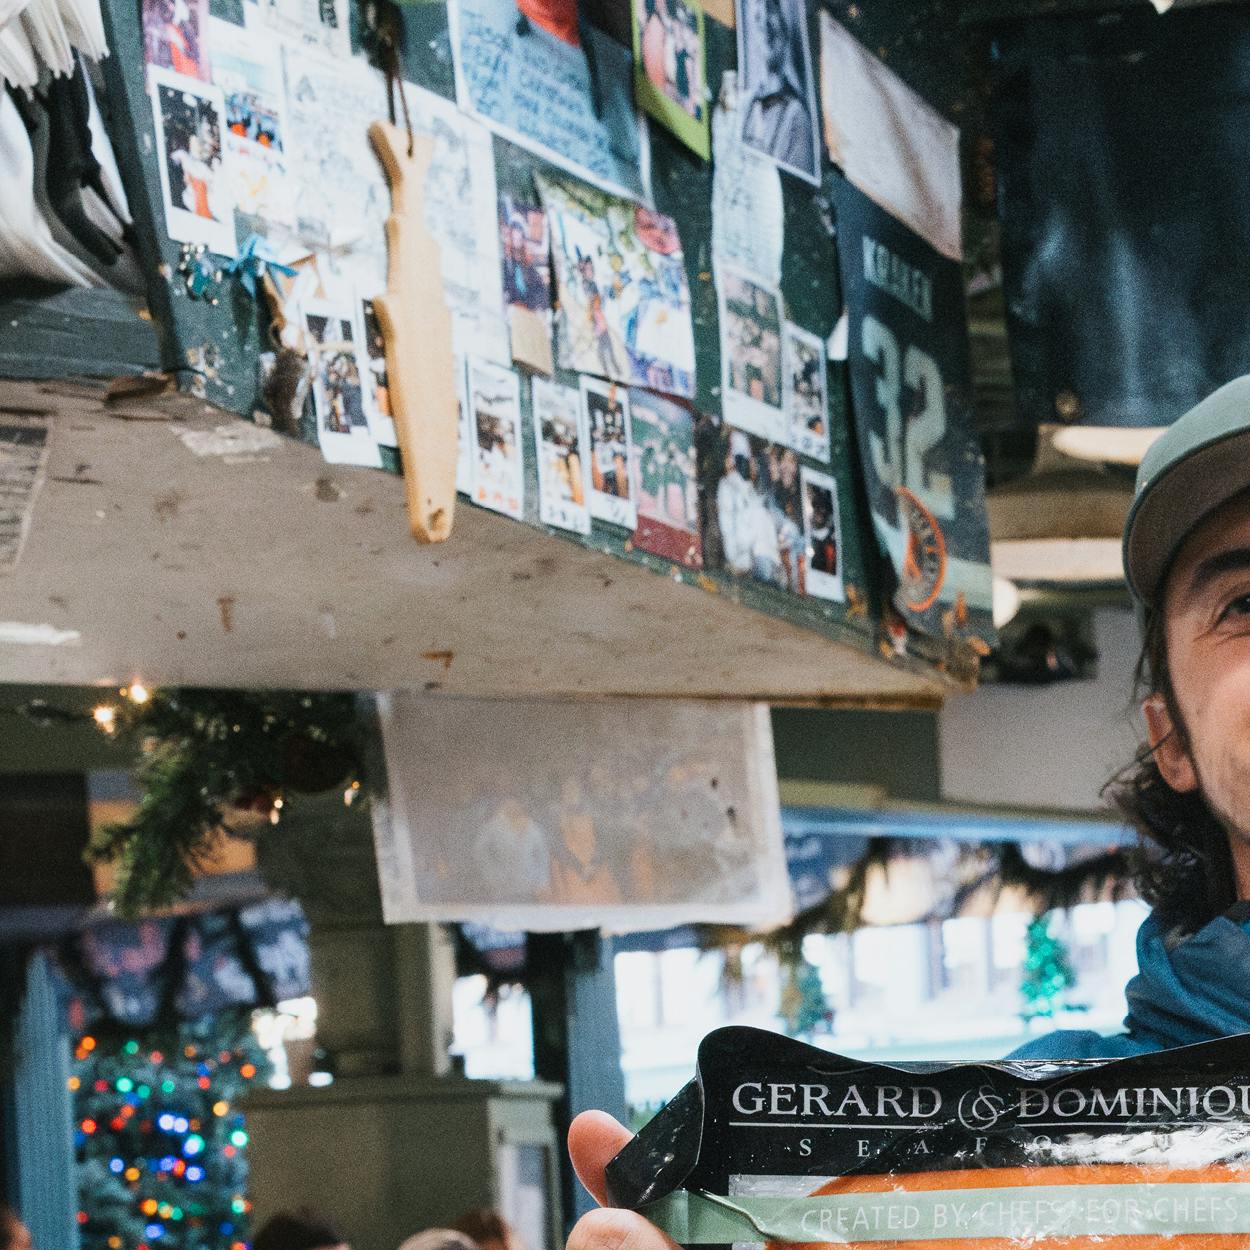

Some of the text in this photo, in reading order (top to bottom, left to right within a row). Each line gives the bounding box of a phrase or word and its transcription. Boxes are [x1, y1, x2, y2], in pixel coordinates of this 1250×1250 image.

[861, 315, 955, 521] 32
[732, 1082, 942, 1118] GERARD
[958, 1085, 1005, 1130] &
[801, 1196, 1238, 1232] CREATED BY CHEFS FOR CHEFS
